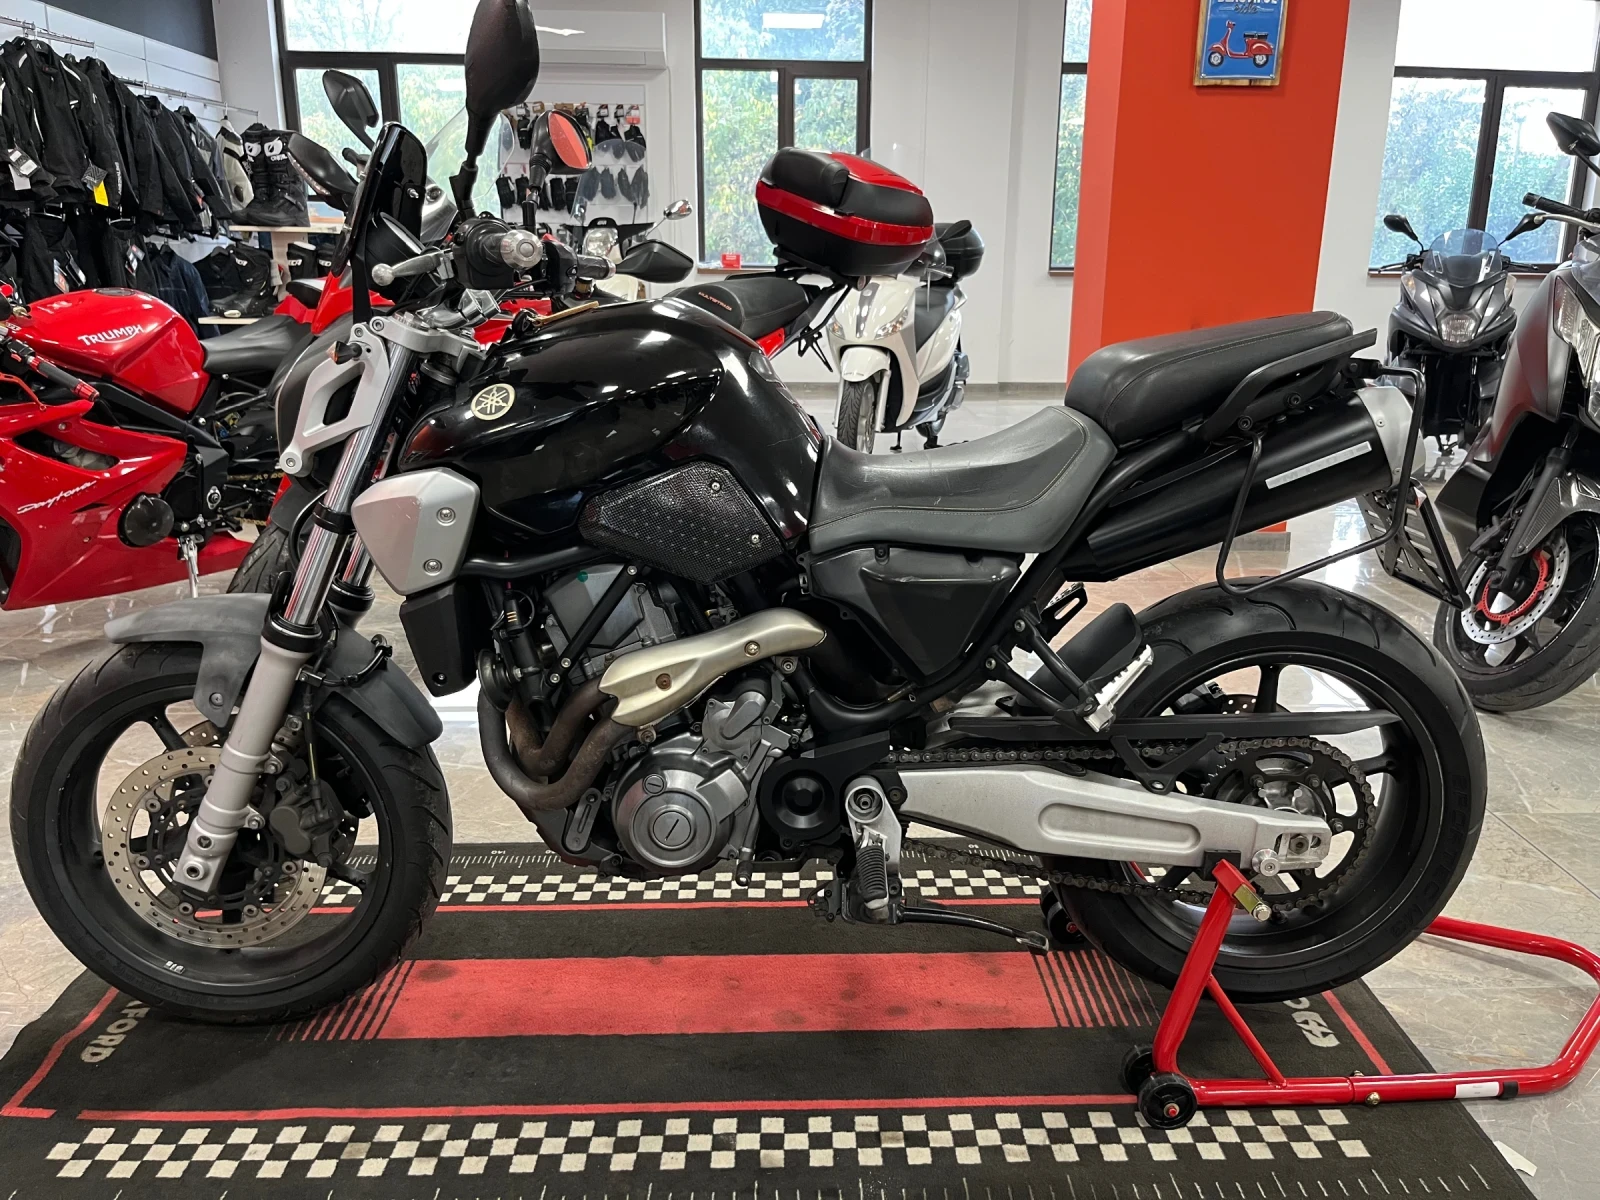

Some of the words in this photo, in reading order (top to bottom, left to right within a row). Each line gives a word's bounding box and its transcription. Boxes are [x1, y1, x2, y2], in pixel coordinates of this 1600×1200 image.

[77, 324, 145, 346] TRIUMPH
[17, 480, 97, 514] Daytona
[81, 1000, 150, 1063] FORD
